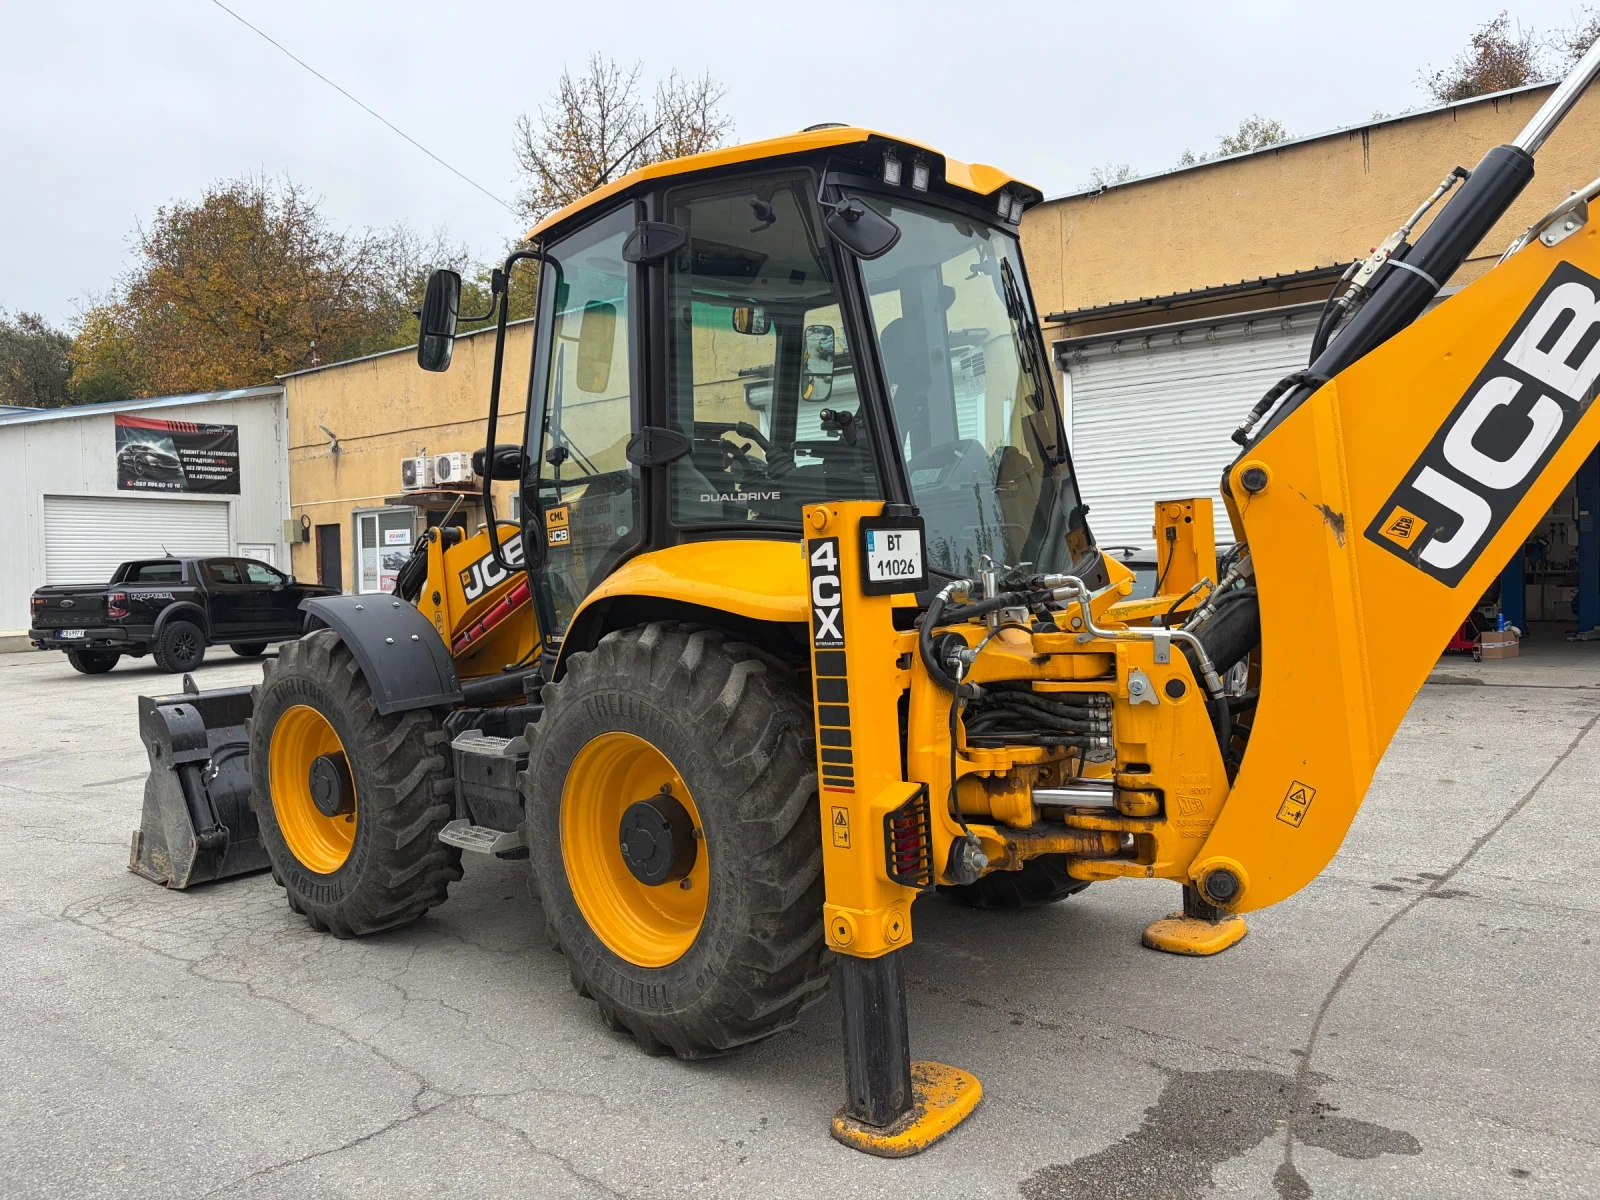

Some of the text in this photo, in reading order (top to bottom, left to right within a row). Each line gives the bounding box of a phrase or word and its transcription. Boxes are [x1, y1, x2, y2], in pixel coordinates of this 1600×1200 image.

[1411, 281, 1600, 569] JCB
[700, 491, 781, 503] DUALDRIVE
[549, 511, 565, 522] CML
[549, 529, 568, 542] JCB
[1391, 516, 1413, 538] JCB
[887, 534, 902, 551] BT
[877, 558, 915, 577] 11026
[130, 592, 175, 601] RAPTOR
[582, 693, 701, 776] TRELLEBORG
[1180, 796, 1204, 815] JCB
[561, 914, 675, 1012] TRELLEBORG
